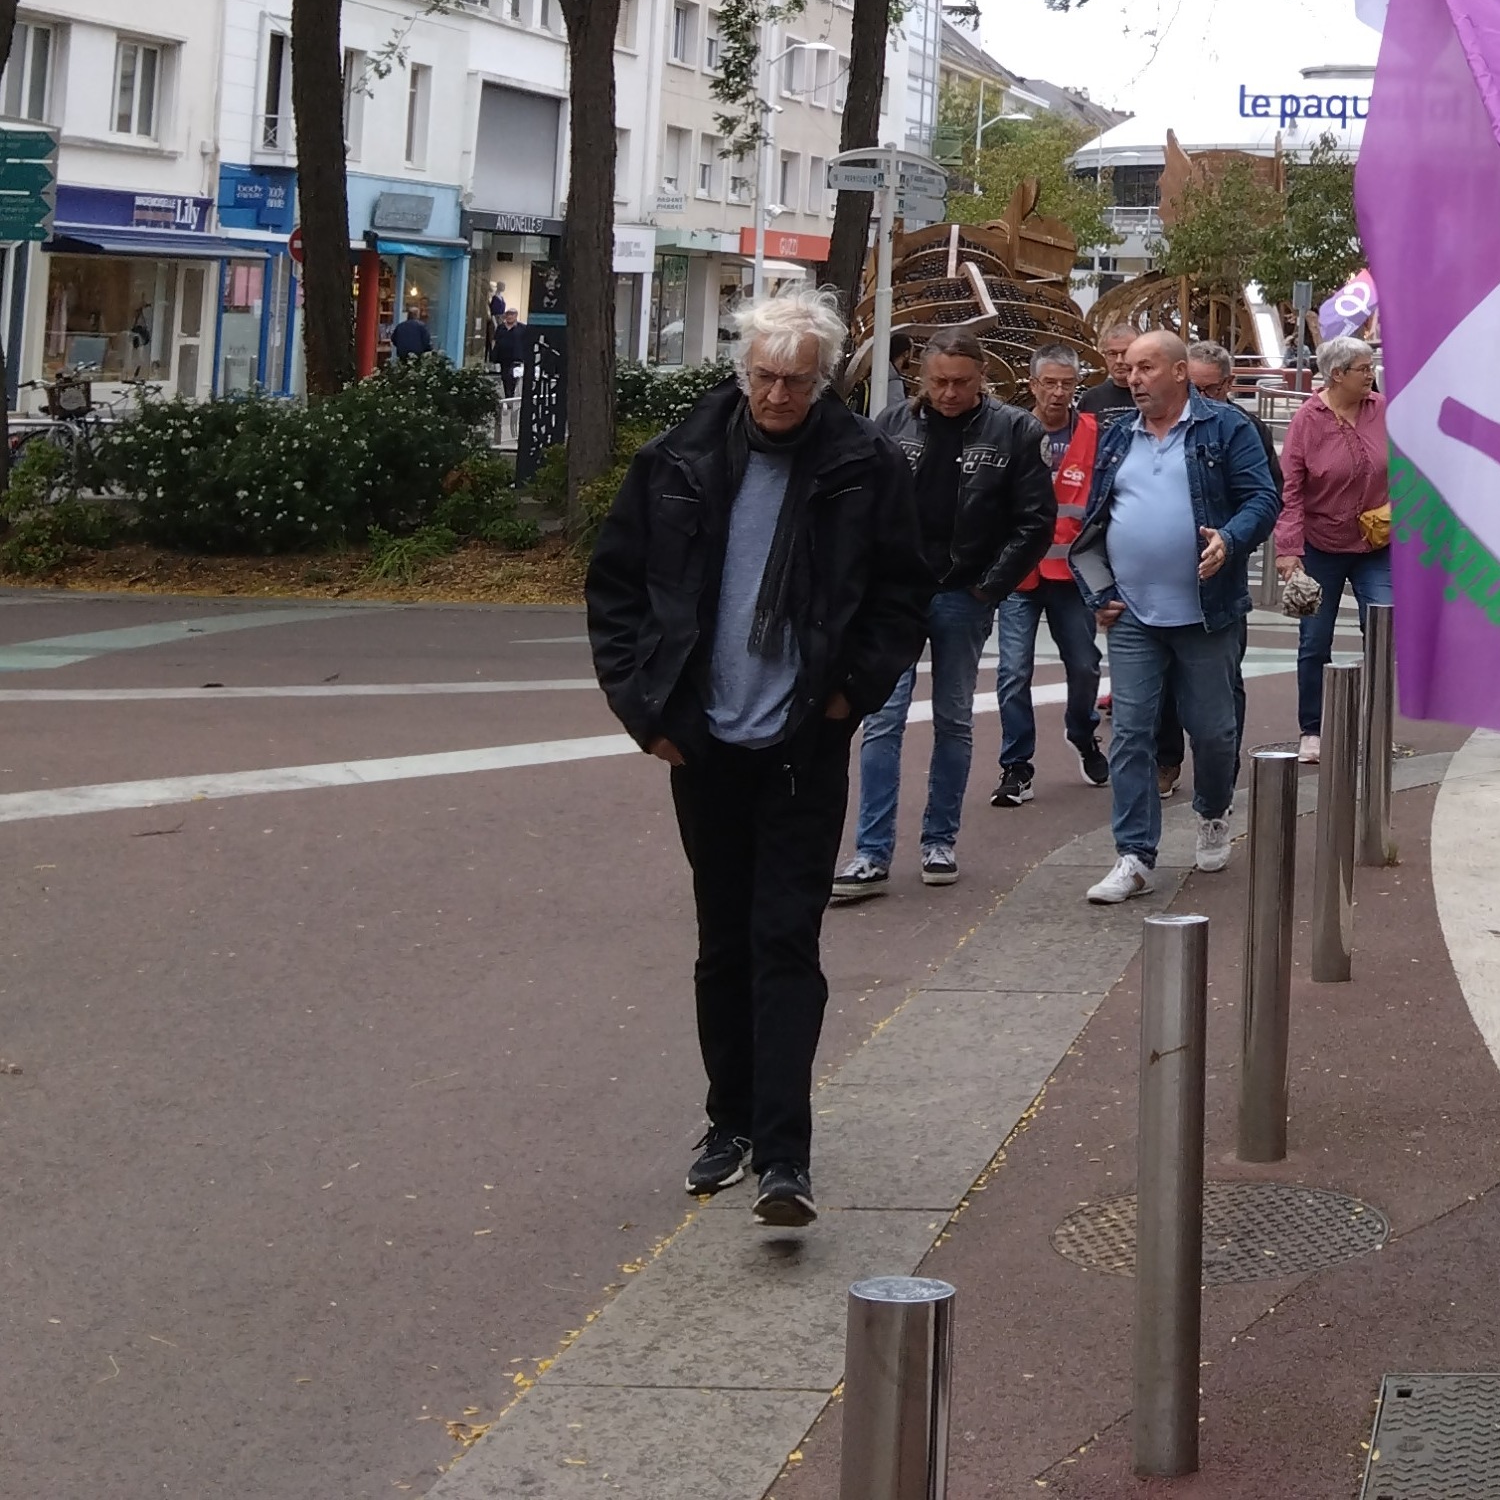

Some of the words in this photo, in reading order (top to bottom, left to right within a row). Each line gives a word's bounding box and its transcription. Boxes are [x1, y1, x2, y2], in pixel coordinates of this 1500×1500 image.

[1239, 84, 1271, 118] le
[1279, 94, 1371, 129] paqu
[176, 198, 200, 230] Lily
[495, 214, 537, 233] ANTONELLE
